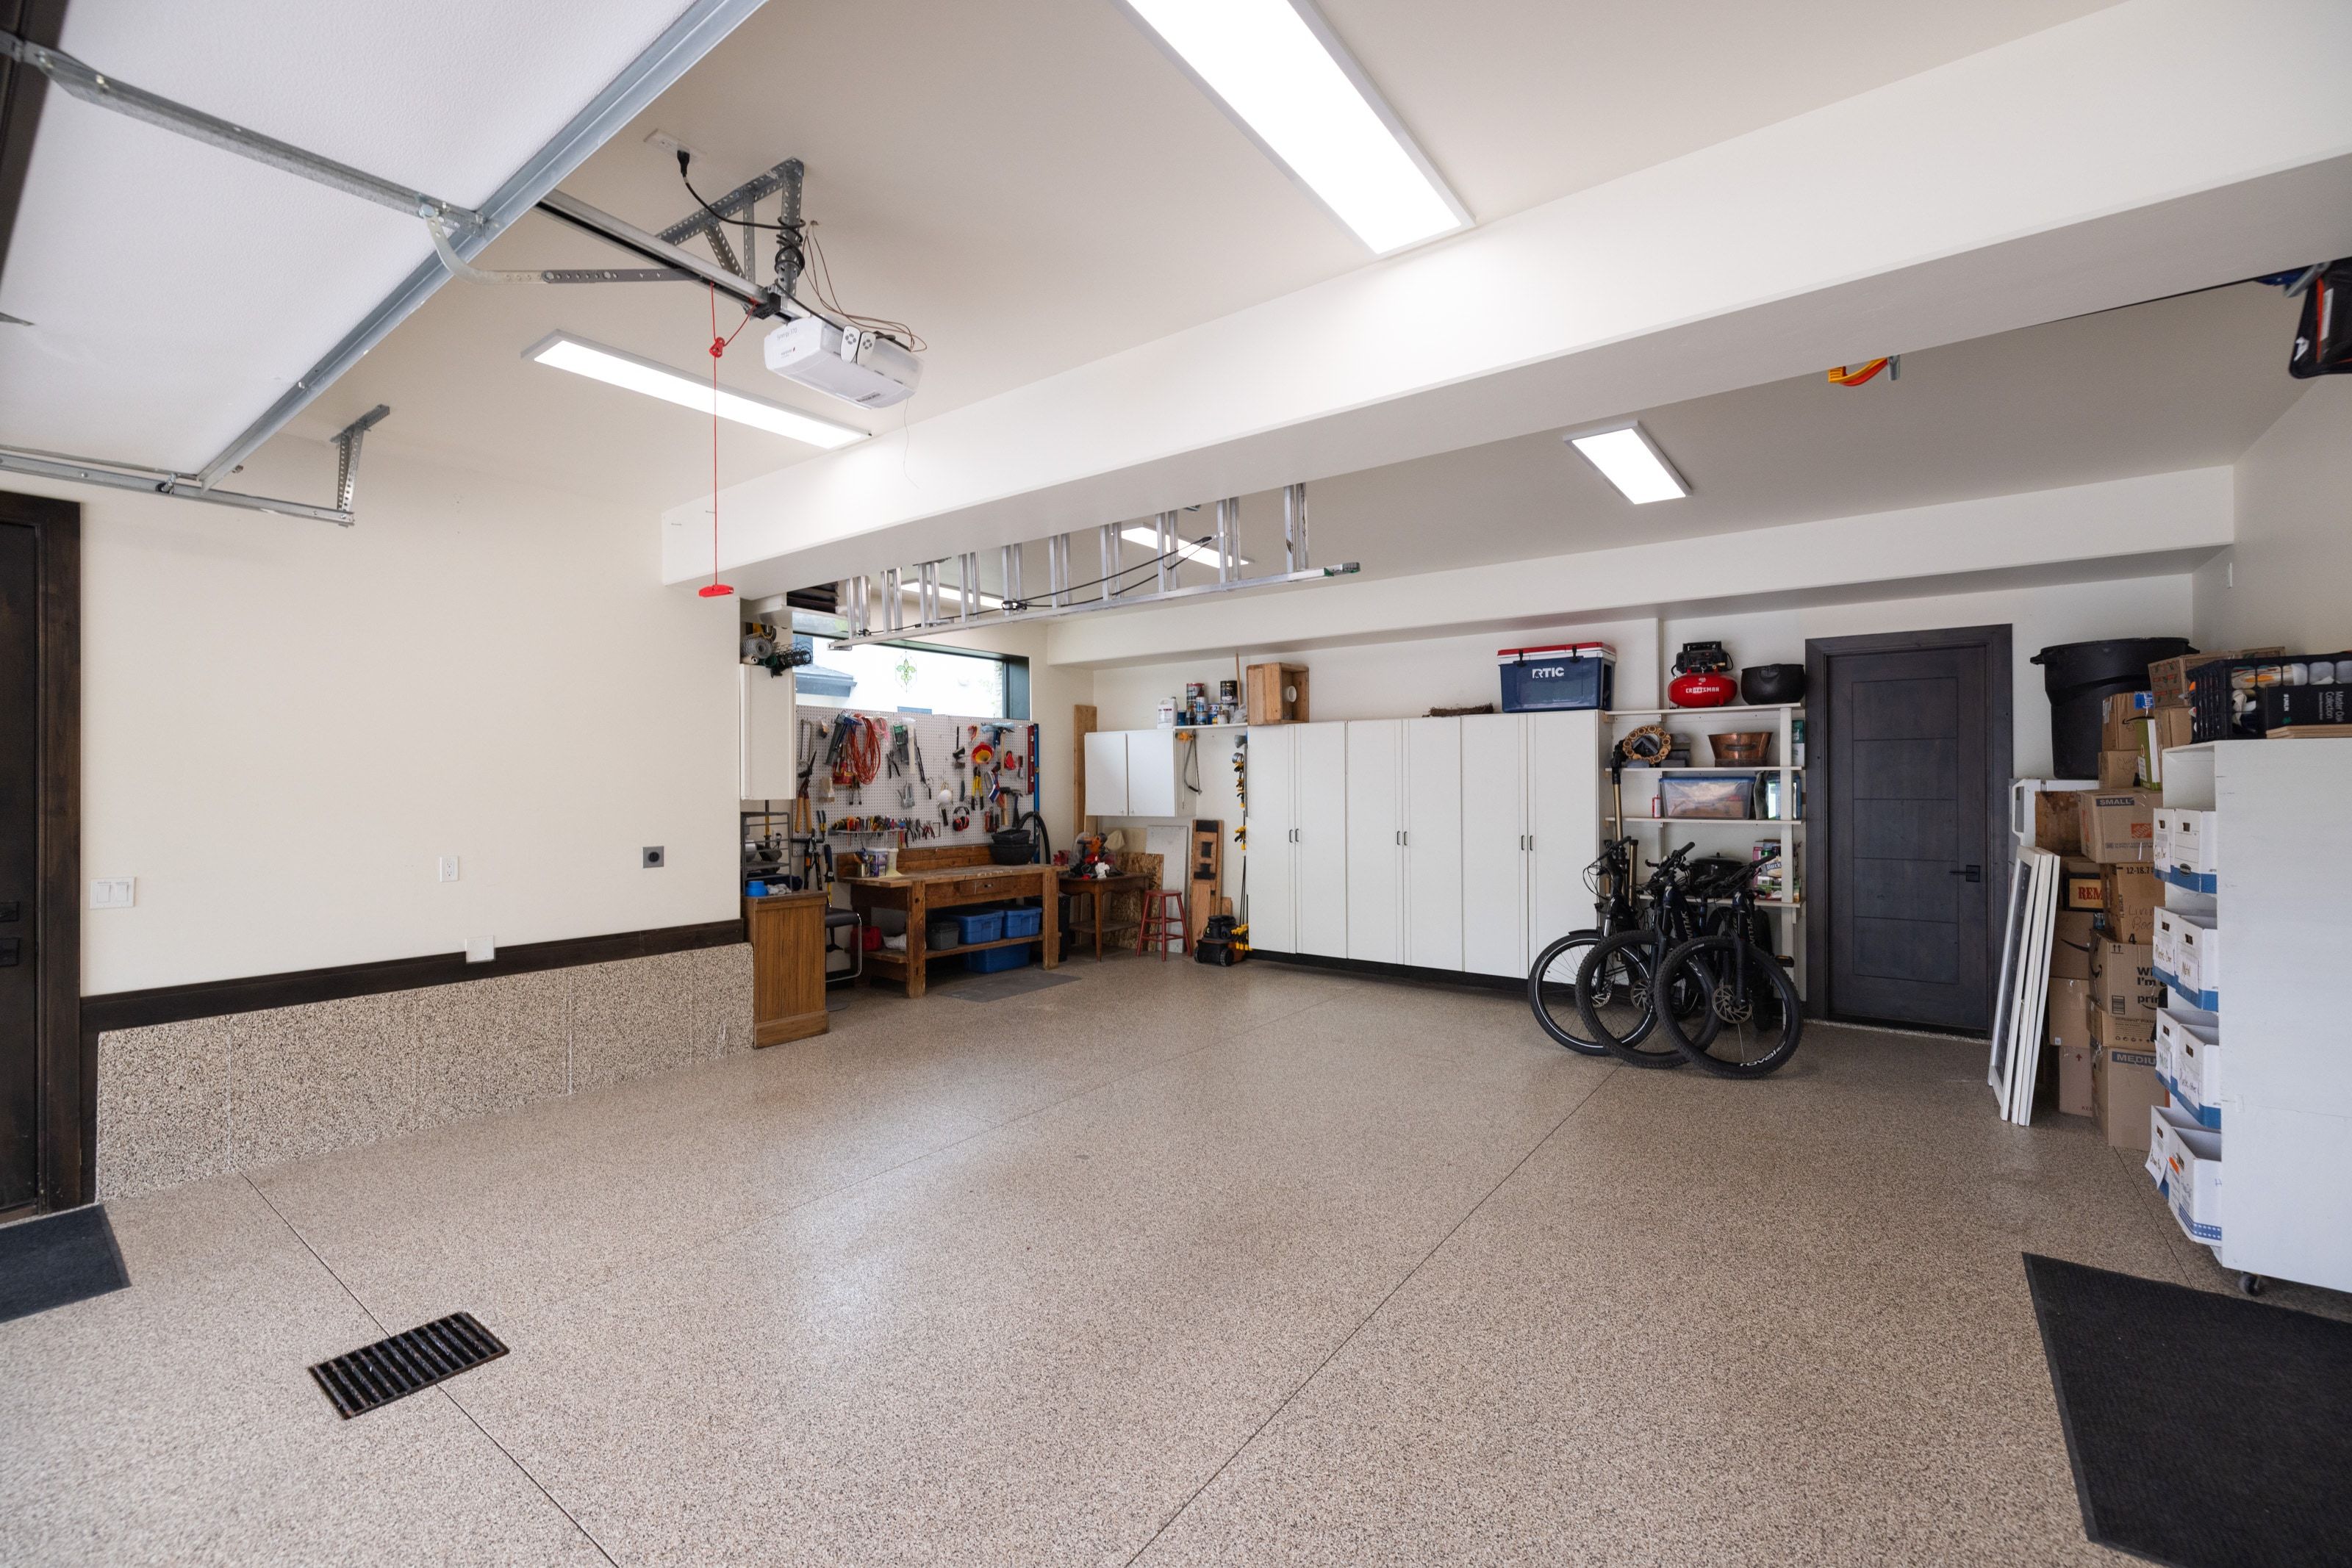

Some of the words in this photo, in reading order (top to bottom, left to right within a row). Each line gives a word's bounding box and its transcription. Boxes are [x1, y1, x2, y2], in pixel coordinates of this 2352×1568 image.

[1532, 666, 1564, 678] RTIC
[2325, 691, 2334, 719] Collection
[2128, 933, 2137, 945] 4
[2137, 977, 2156, 985] I'm
[2116, 1054, 2156, 1065] MEDIU
